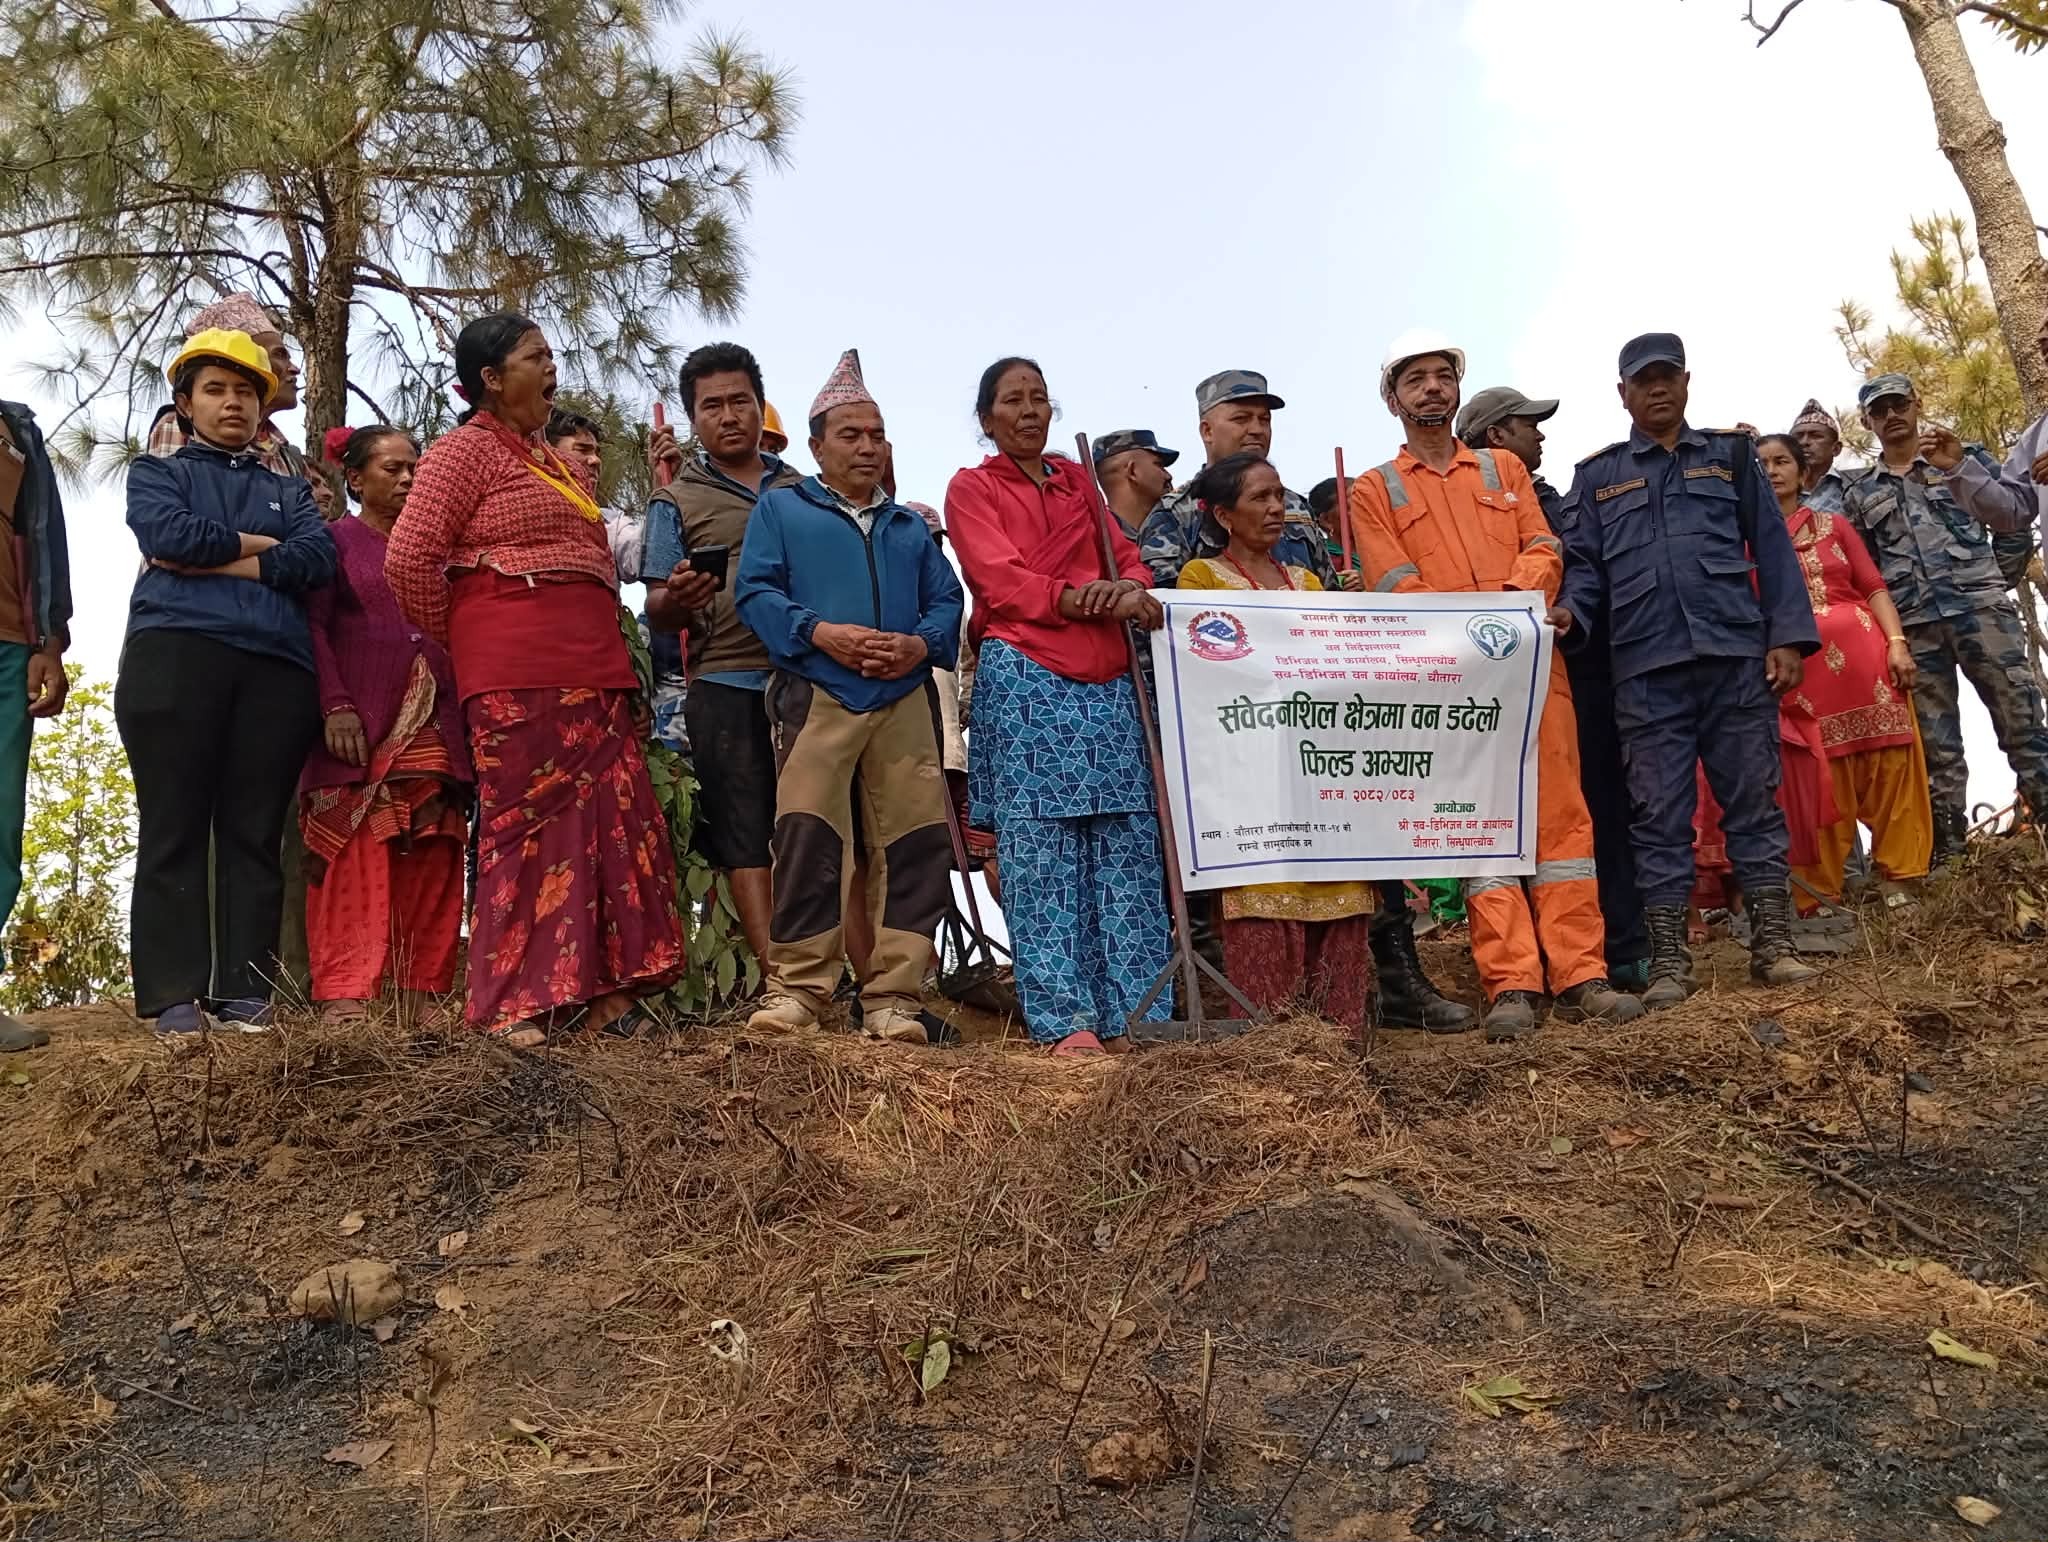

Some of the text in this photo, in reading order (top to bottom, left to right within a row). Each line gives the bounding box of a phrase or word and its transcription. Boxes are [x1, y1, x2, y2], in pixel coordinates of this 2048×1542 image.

[1371, 615, 1408, 624] सरकार
[1288, 628, 1305, 638] वन
[1309, 629, 1329, 638] तथा
[1333, 630, 1381, 639] वातावरण
[1324, 644, 1341, 652] वन
[1275, 655, 1319, 665] डिभिजन
[1323, 657, 1339, 665] वन
[1351, 670, 1369, 680] वन
[1427, 669, 1464, 684] चौतारा
[1217, 690, 1503, 734] संवेदनशिल क्षेत्रमा वन डढेलो
[1299, 739, 1434, 779] फिल्ड अभ्यास
[1353, 789, 1415, 803] २०८२/०८३
[1433, 800, 1477, 814] आयोजक
[1465, 820, 1479, 830] वन
[1481, 817, 1514, 830] कार्यालय
[1200, 830, 1223, 841] स्थान
[1234, 825, 1265, 838] चौतारा
